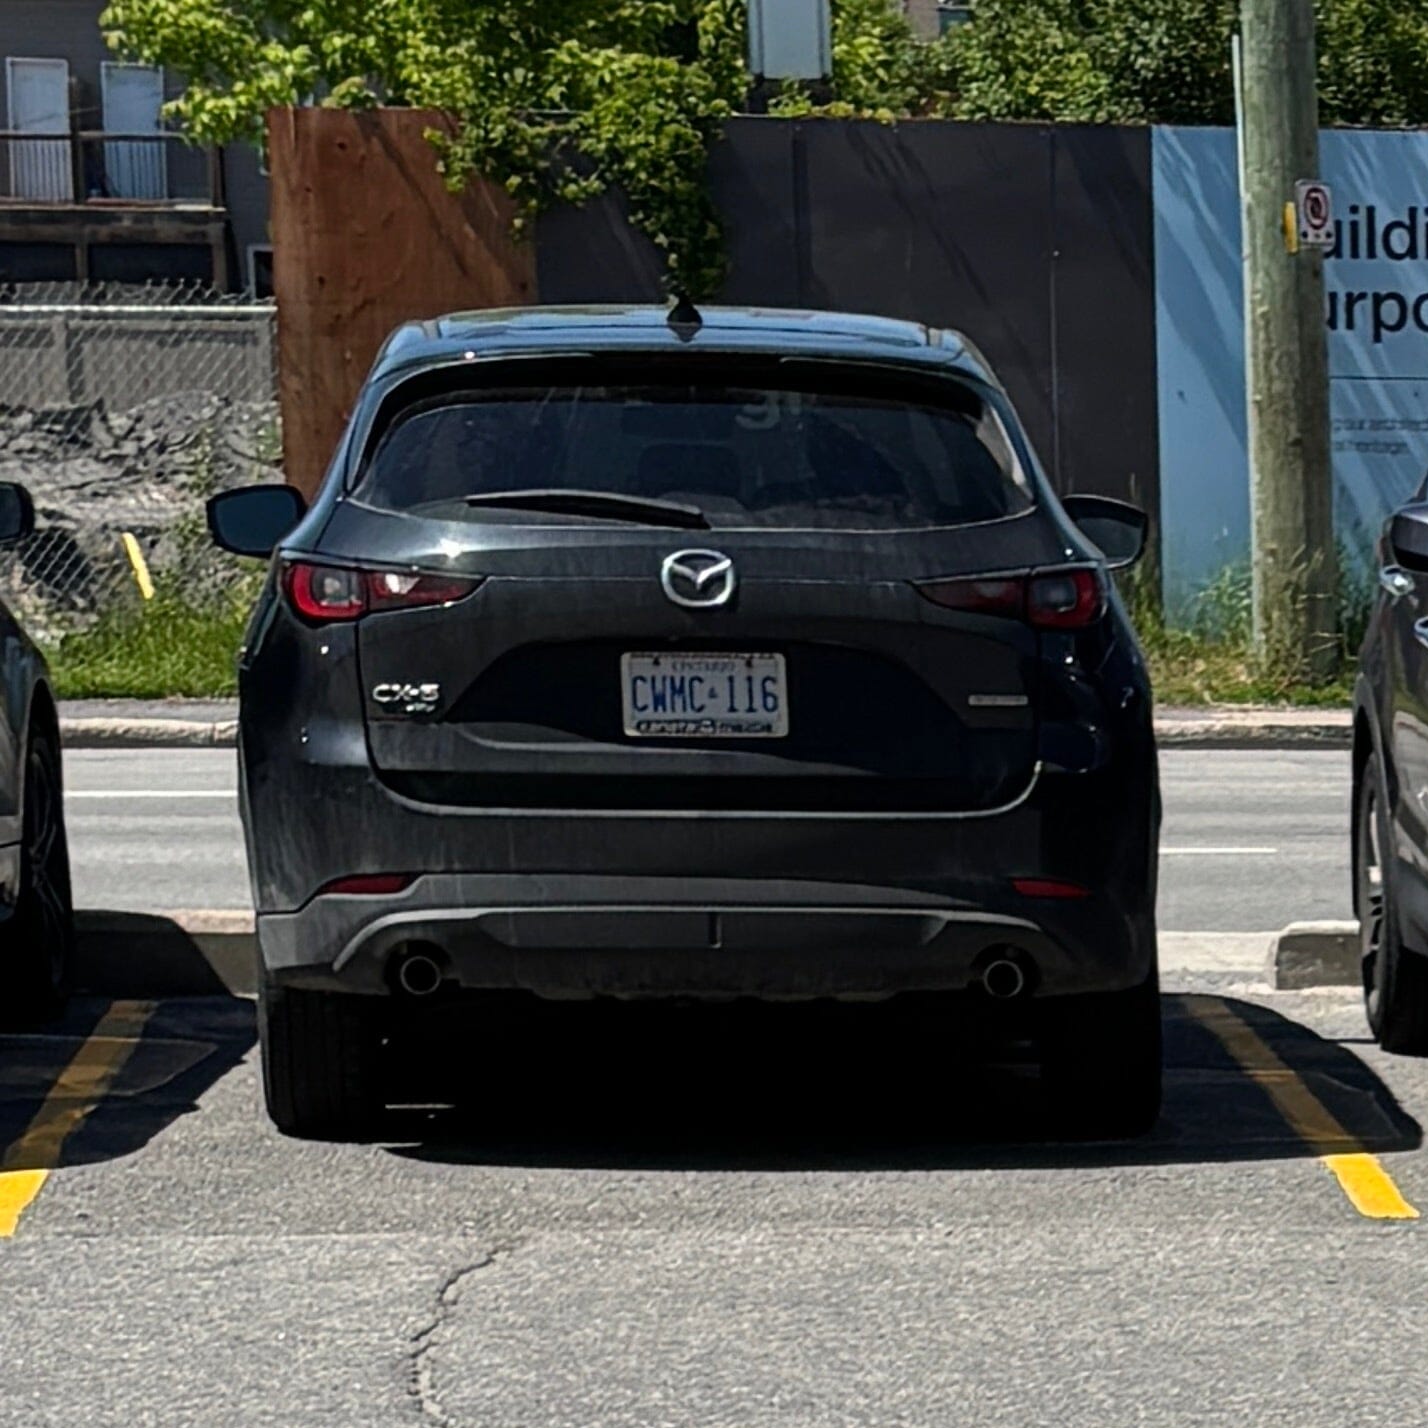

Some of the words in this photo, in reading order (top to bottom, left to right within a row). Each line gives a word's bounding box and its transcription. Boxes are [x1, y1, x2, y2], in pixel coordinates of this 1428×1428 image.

[372, 683, 441, 703] CX-5
[632, 675, 705, 713] CWMC
[726, 675, 779, 713] 116
